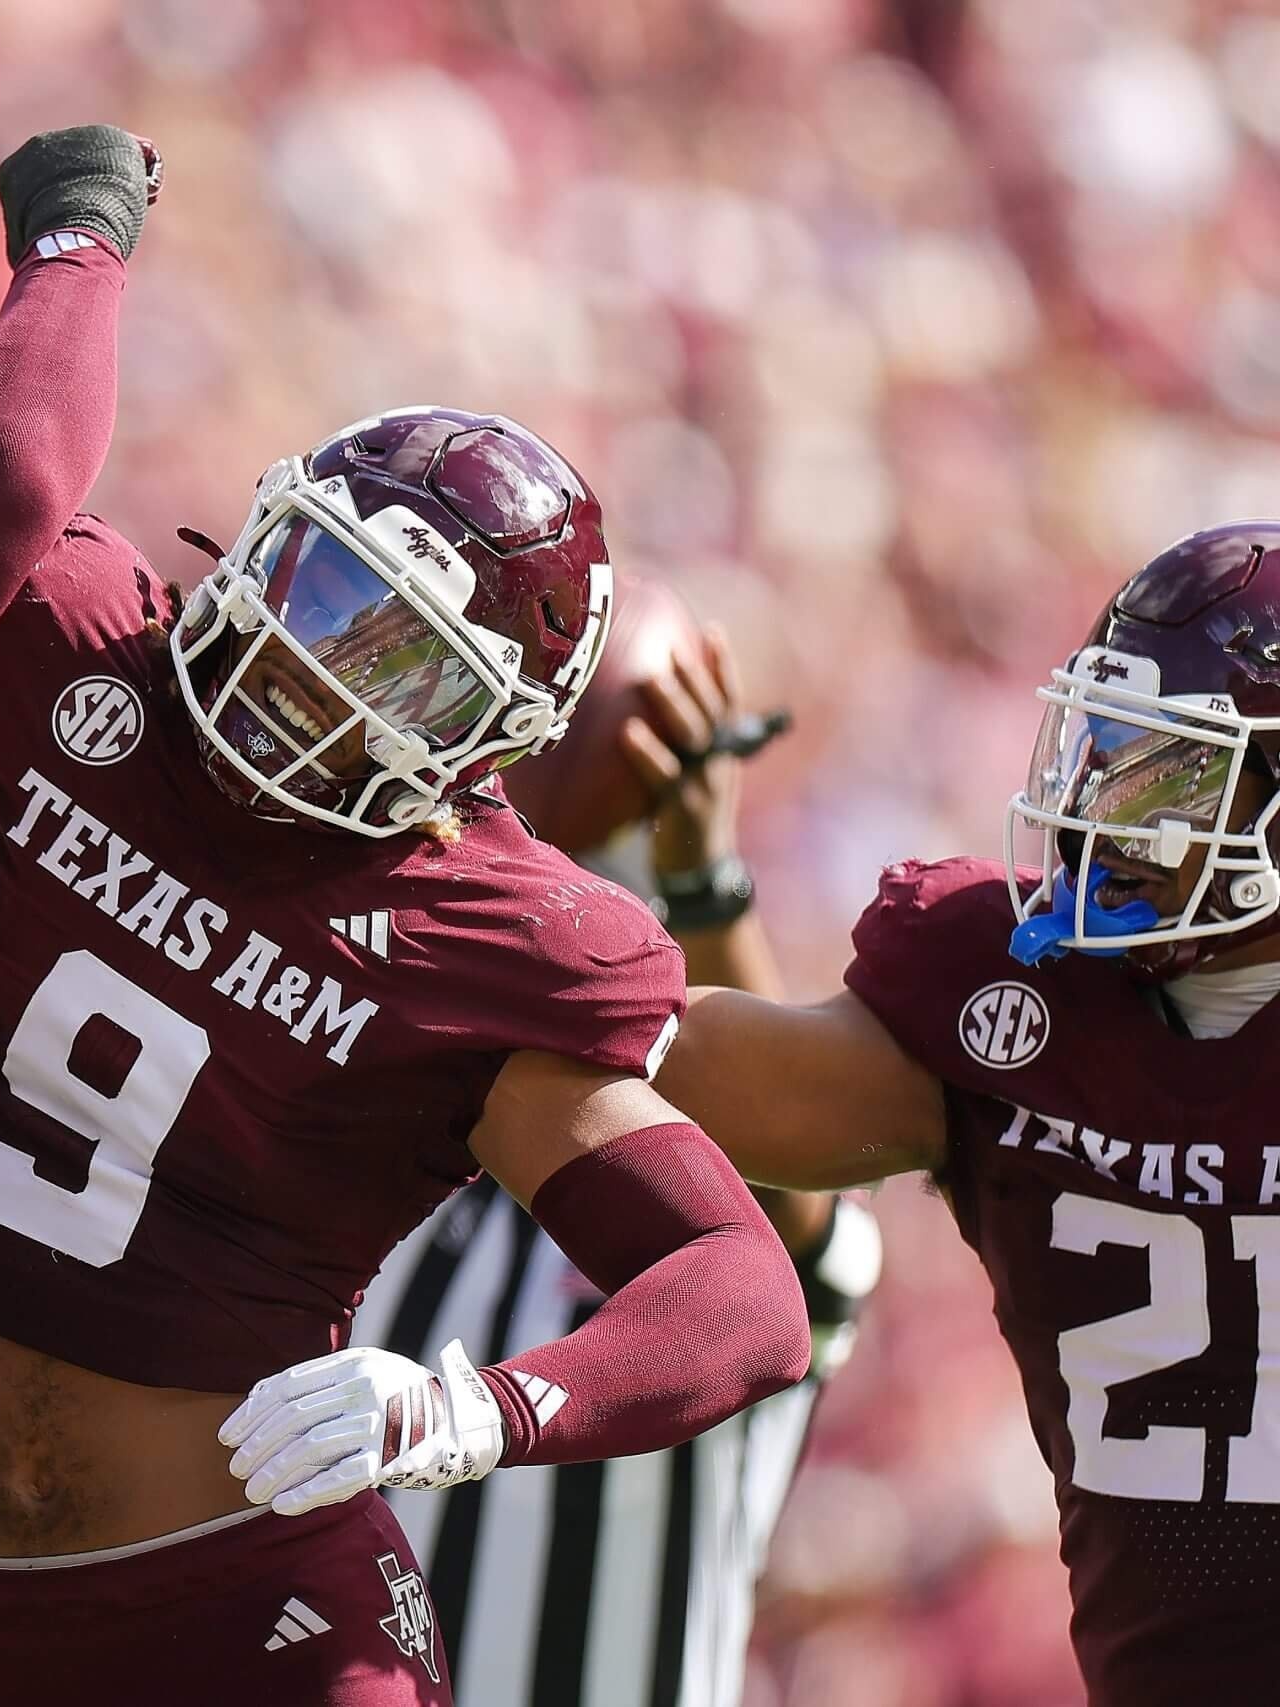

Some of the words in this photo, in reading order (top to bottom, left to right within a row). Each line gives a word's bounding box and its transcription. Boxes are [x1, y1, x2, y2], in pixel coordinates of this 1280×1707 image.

[402, 526, 451, 573] Aggies
[58, 681, 138, 759] SEC
[6, 767, 229, 971] TEXAS
[210, 929, 380, 1067] A&M
[966, 987, 1043, 1063] SEC
